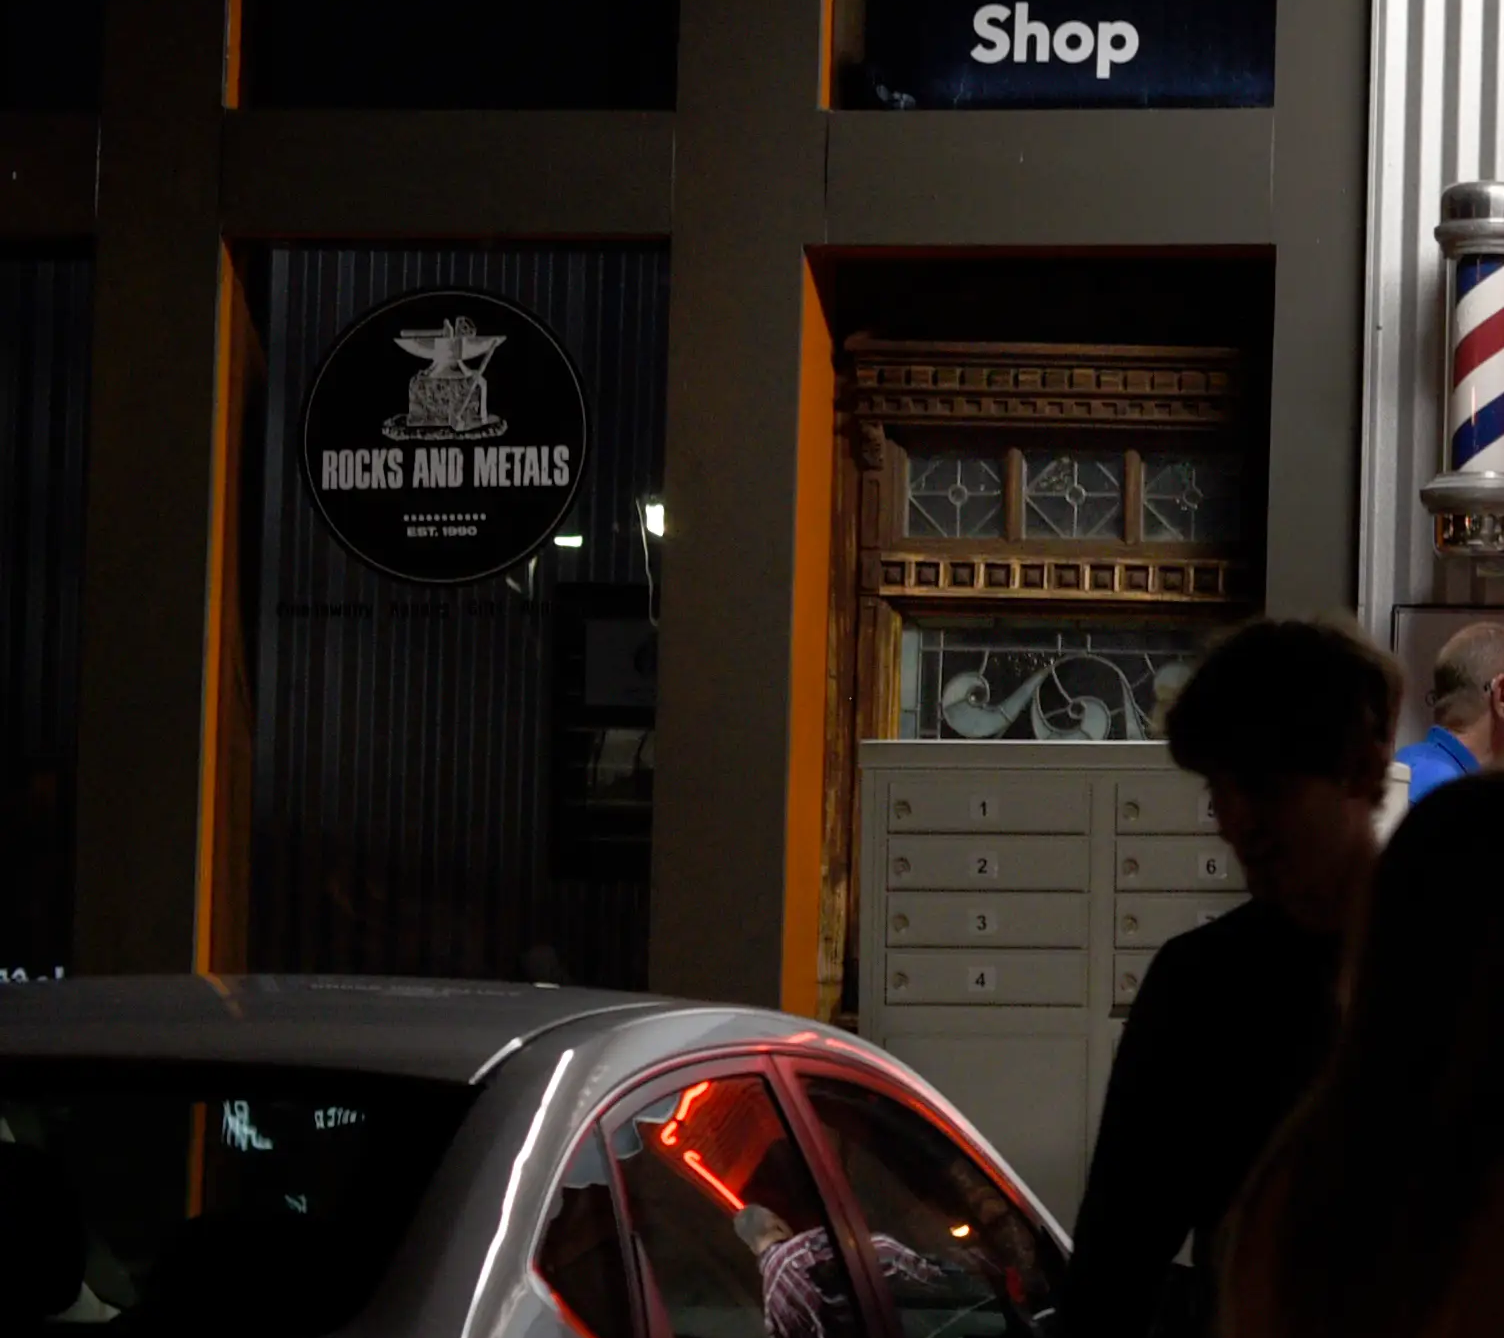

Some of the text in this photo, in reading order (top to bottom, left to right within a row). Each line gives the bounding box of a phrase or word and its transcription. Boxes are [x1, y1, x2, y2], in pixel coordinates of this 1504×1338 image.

[970, 1, 1140, 79] Shop
[321, 445, 570, 490] ROCKS AND METALS
[406, 526, 439, 537] EST.
